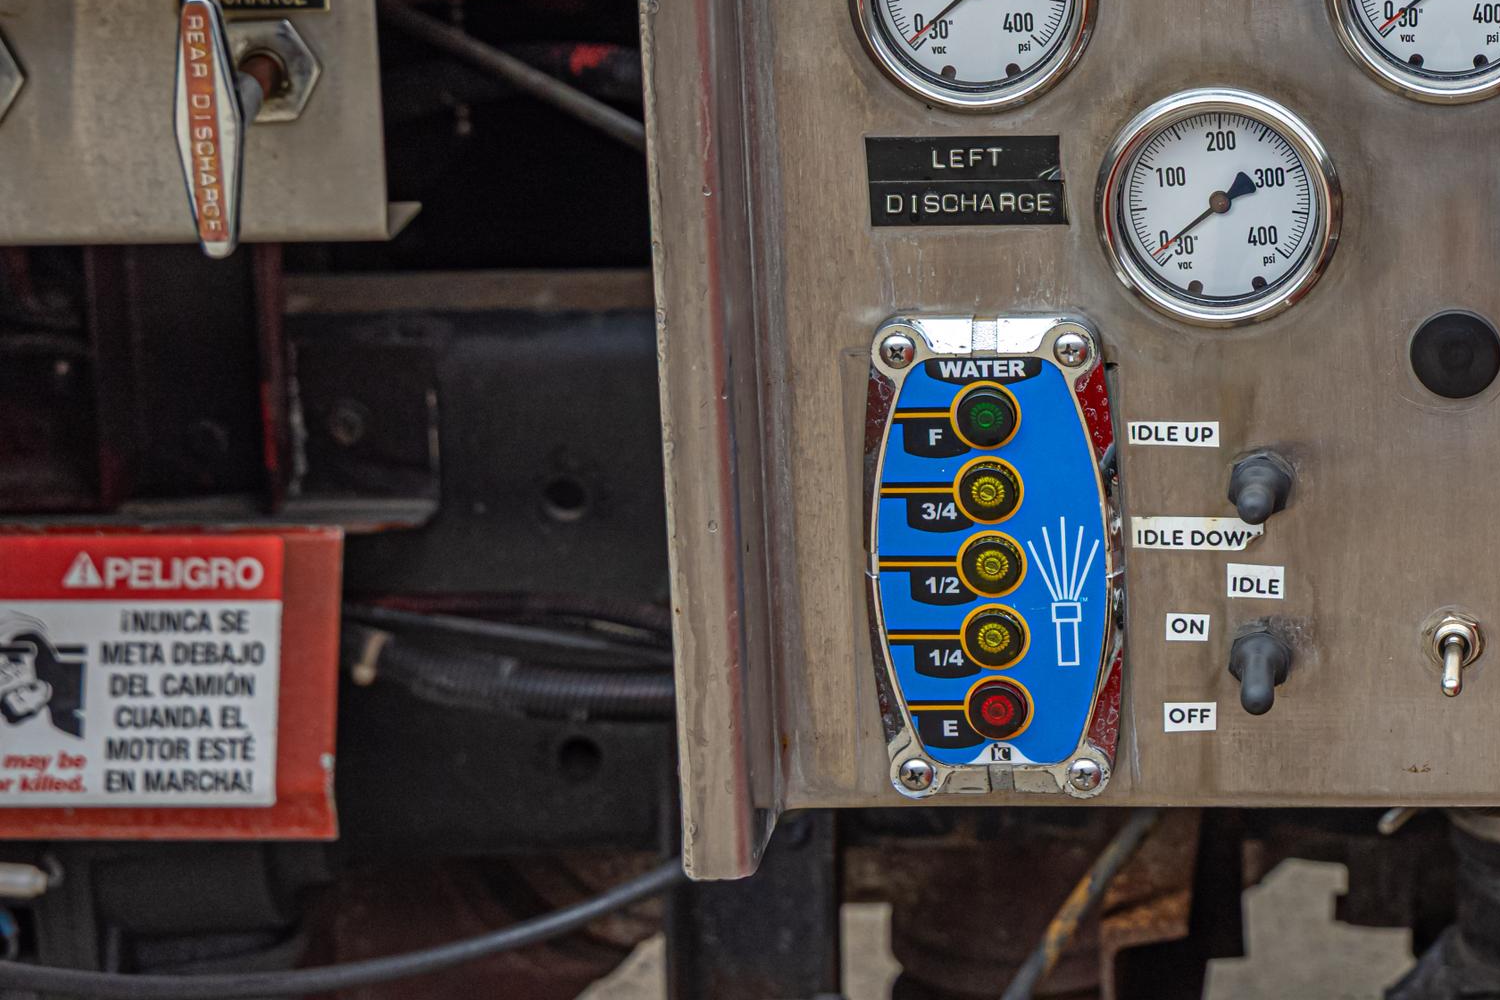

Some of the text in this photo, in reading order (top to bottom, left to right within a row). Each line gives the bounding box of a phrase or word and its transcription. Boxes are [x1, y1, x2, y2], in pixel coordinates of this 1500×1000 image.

[1384, 1, 1393, 20] 0
[914, 14, 923, 32] 0
[1003, 12, 1033, 32] 400
[186, 15, 208, 78] REAR
[1401, 34, 1415, 42] vac
[1487, 33, 1498, 45] psi
[932, 45, 946, 54] vac
[1018, 41, 1030, 54] psi
[1206, 130, 1236, 151] 200
[932, 148, 1003, 168] LEFT
[1156, 167, 1185, 187] 100
[1255, 167, 1284, 188] 300
[886, 193, 1053, 214] DISCHARGE
[1160, 230, 1169, 249] 0
[1248, 226, 1277, 246] 400
[1178, 261, 1192, 270] vac
[1263, 253, 1275, 266] psi
[939, 360, 1026, 378] WATER
[929, 429, 942, 445] F
[1132, 425, 1213, 442] IDLE UP
[921, 503, 957, 520] 3/4
[1138, 530, 1183, 546] IDLE
[105, 558, 264, 588] PELIGRO
[925, 577, 960, 594] 1/2
[1232, 577, 1280, 595] IDLE
[219, 610, 249, 634] SE
[1172, 618, 1204, 635] ON
[101, 642, 265, 666] META DEBAJO
[930, 650, 964, 666] 1/4
[110, 669, 255, 697] DEL CAMIÓN
[115, 706, 246, 729] CUANDA EL
[1169, 709, 1211, 724] OFF
[943, 720, 959, 736] E
[106, 732, 254, 761] MOTOR ESTÉ
[4, 751, 86, 773] may be
[105, 770, 253, 793] EN MARCHA!
